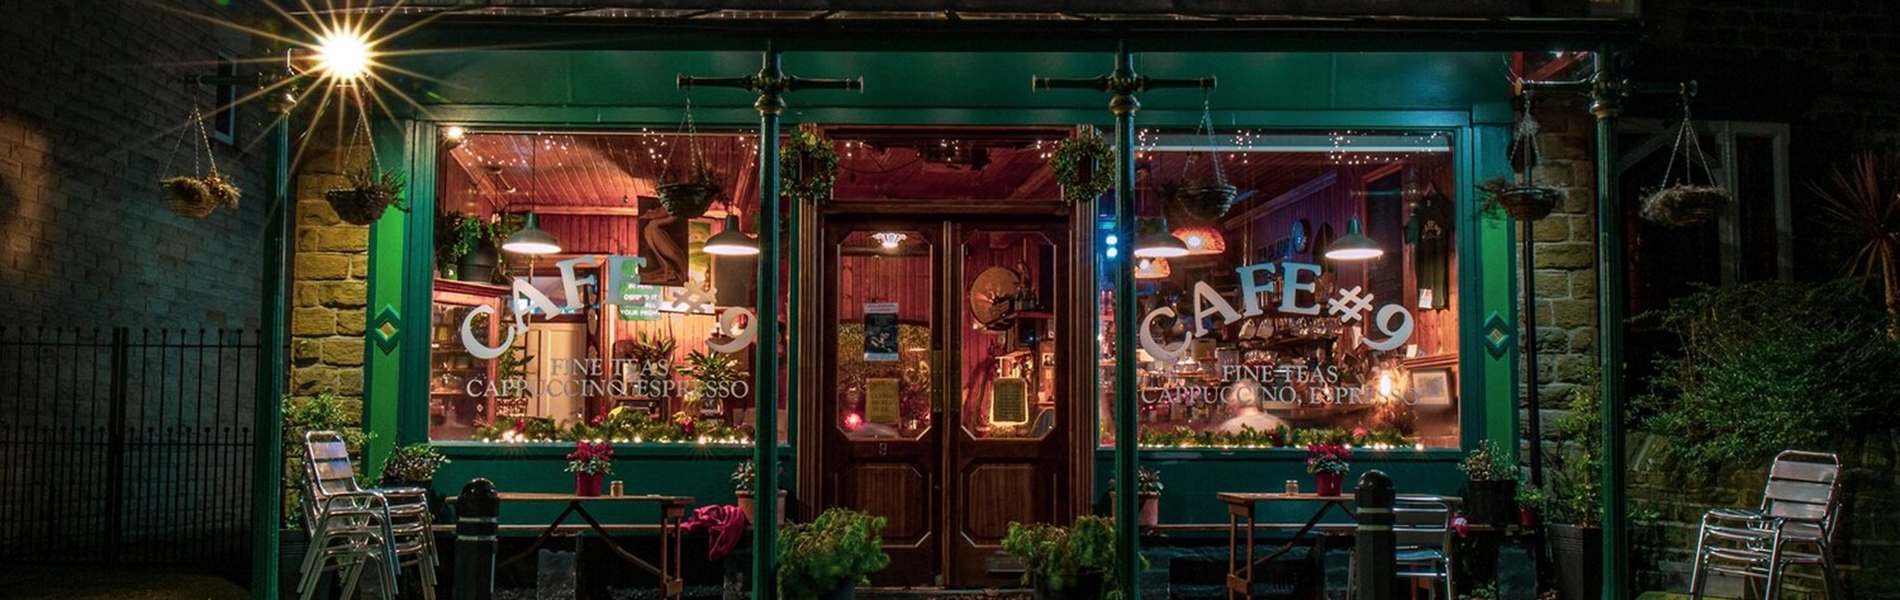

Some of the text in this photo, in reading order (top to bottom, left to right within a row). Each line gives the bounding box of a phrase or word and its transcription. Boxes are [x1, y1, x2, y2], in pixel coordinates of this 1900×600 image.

[461, 255, 757, 360] CAFE #9
[1140, 261, 1414, 362] CAFE #9
[551, 358, 670, 376] FINE TEAS
[1221, 365, 1339, 384] FINE TEAS
[636, 379, 749, 398] ESPRESSO
[1140, 386, 1421, 406] CAPPUCCINO, ESPRESSO
[879, 442, 888, 456] 9
